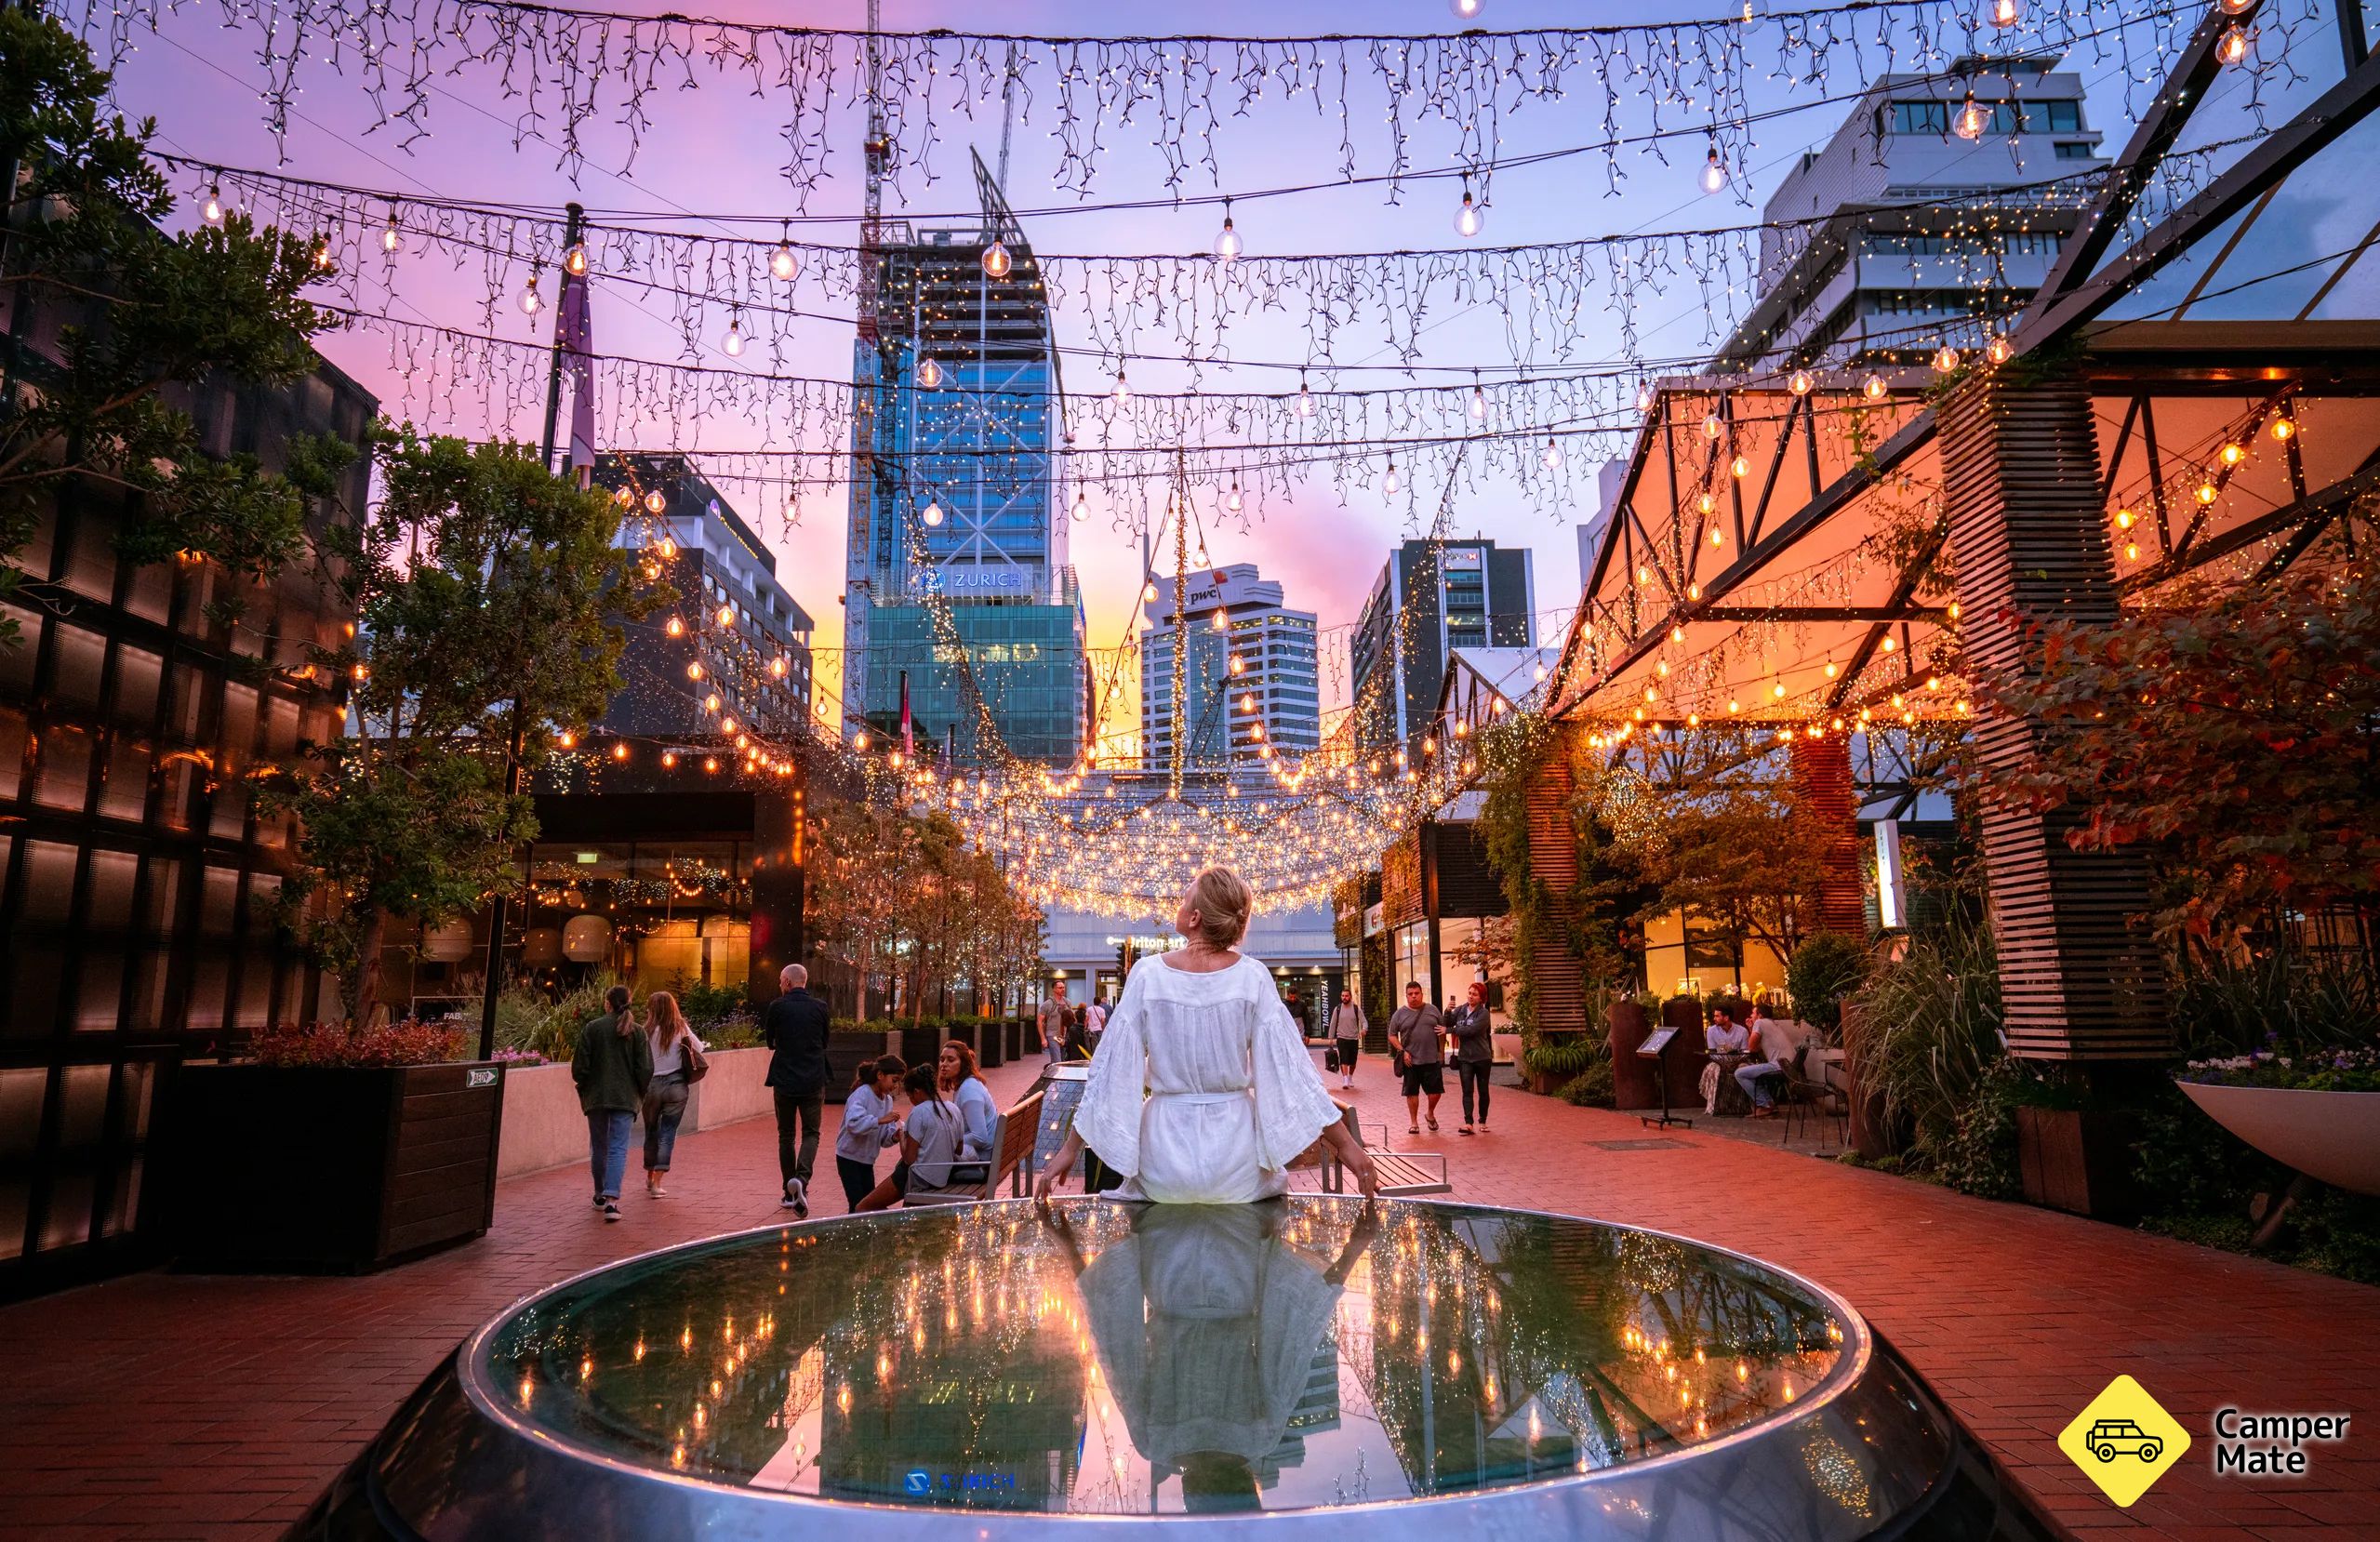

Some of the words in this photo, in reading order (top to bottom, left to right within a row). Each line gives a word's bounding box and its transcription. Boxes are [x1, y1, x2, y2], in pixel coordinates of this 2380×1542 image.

[954, 573, 1021, 587] ZURICH
[1190, 589, 1217, 605] pwc
[1321, 980, 1329, 1032] YEAHBOWL
